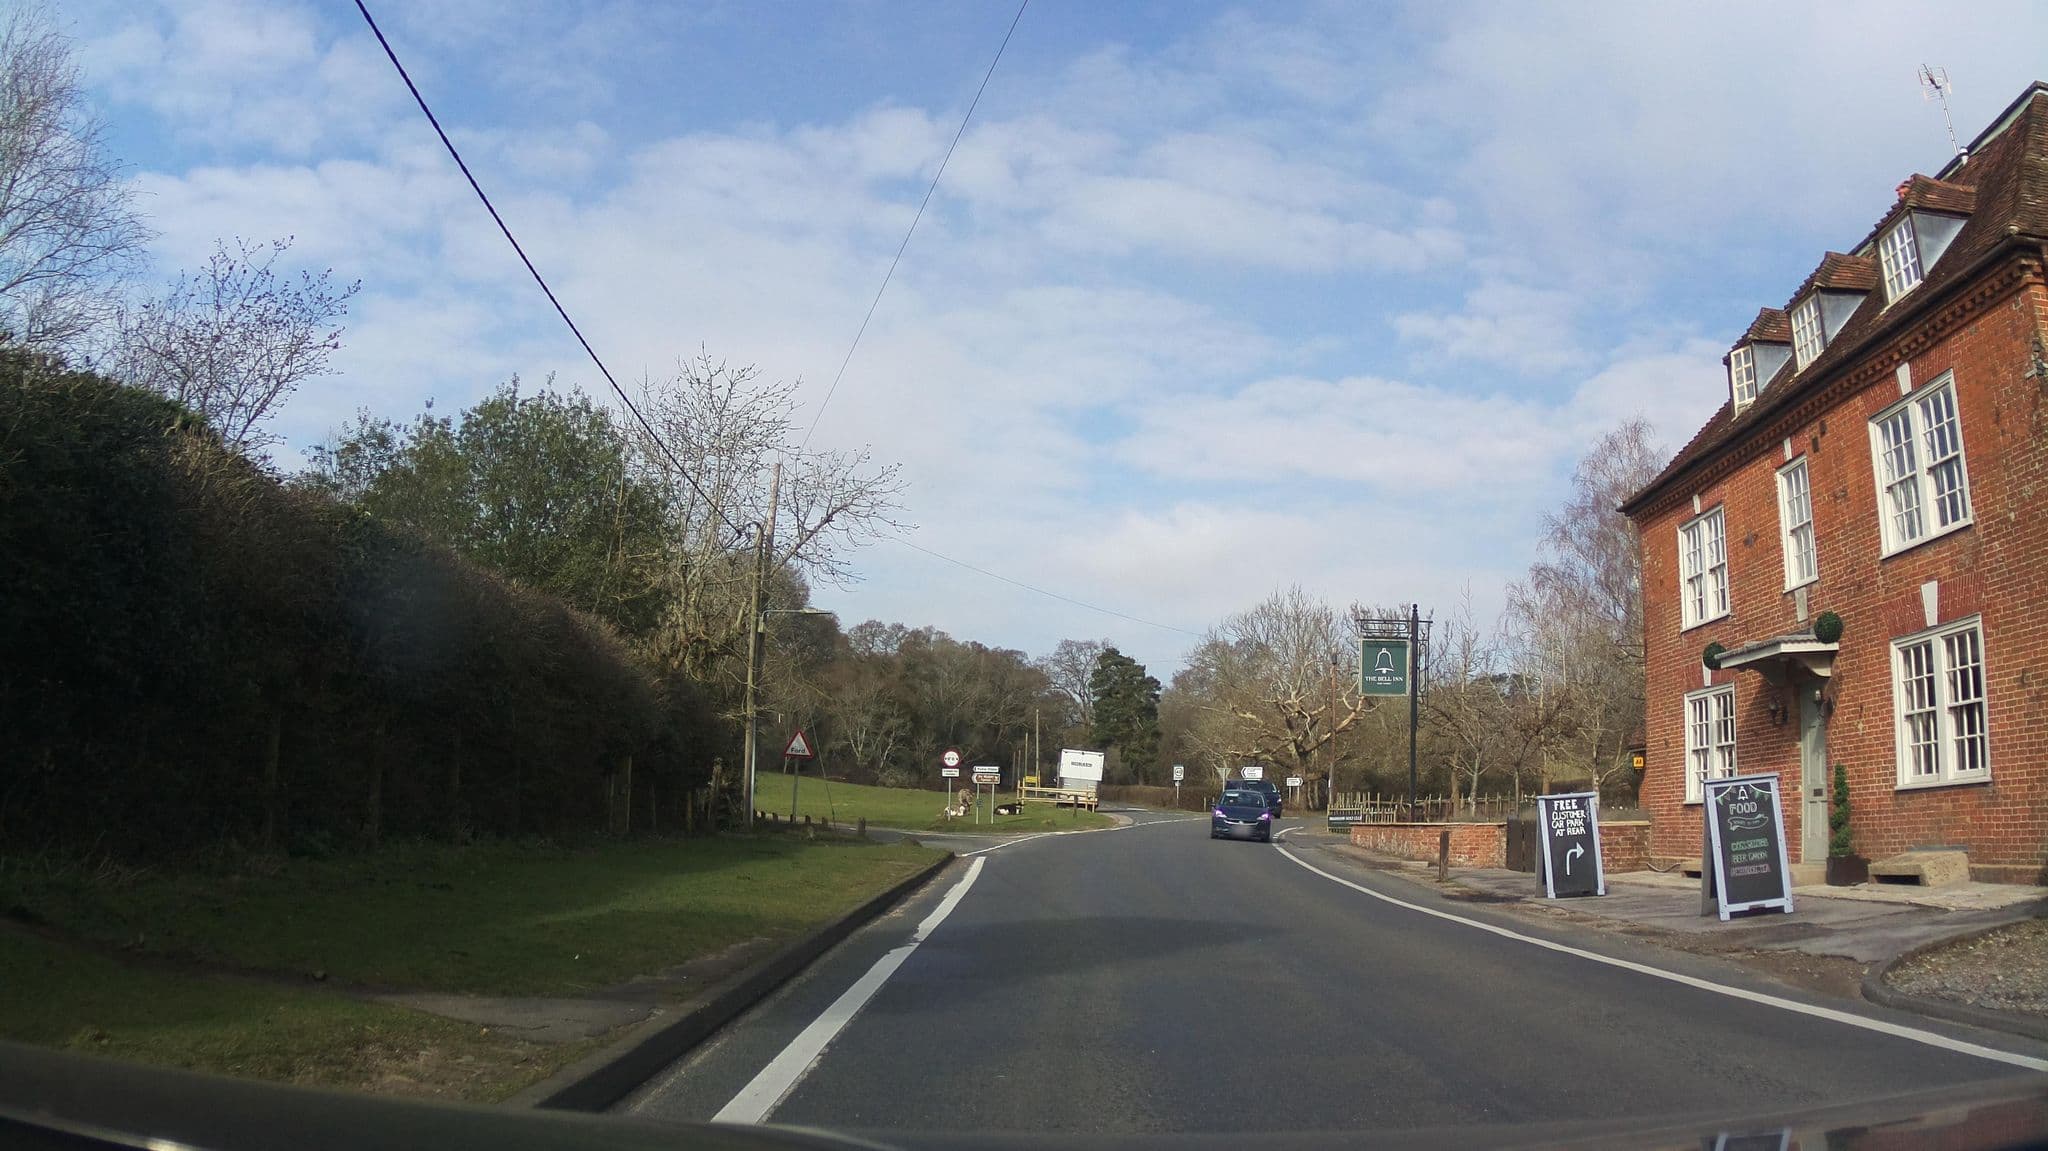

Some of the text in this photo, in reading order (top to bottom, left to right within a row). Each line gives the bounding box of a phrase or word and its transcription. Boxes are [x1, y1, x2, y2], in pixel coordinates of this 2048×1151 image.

[1554, 799, 1578, 811] FREE
[1729, 802, 1758, 815] FOOD
[1552, 810, 1586, 821] CUSTOMER
[1552, 818, 1585, 829] CAR PARK
[1556, 827, 1586, 837] AT REAR
